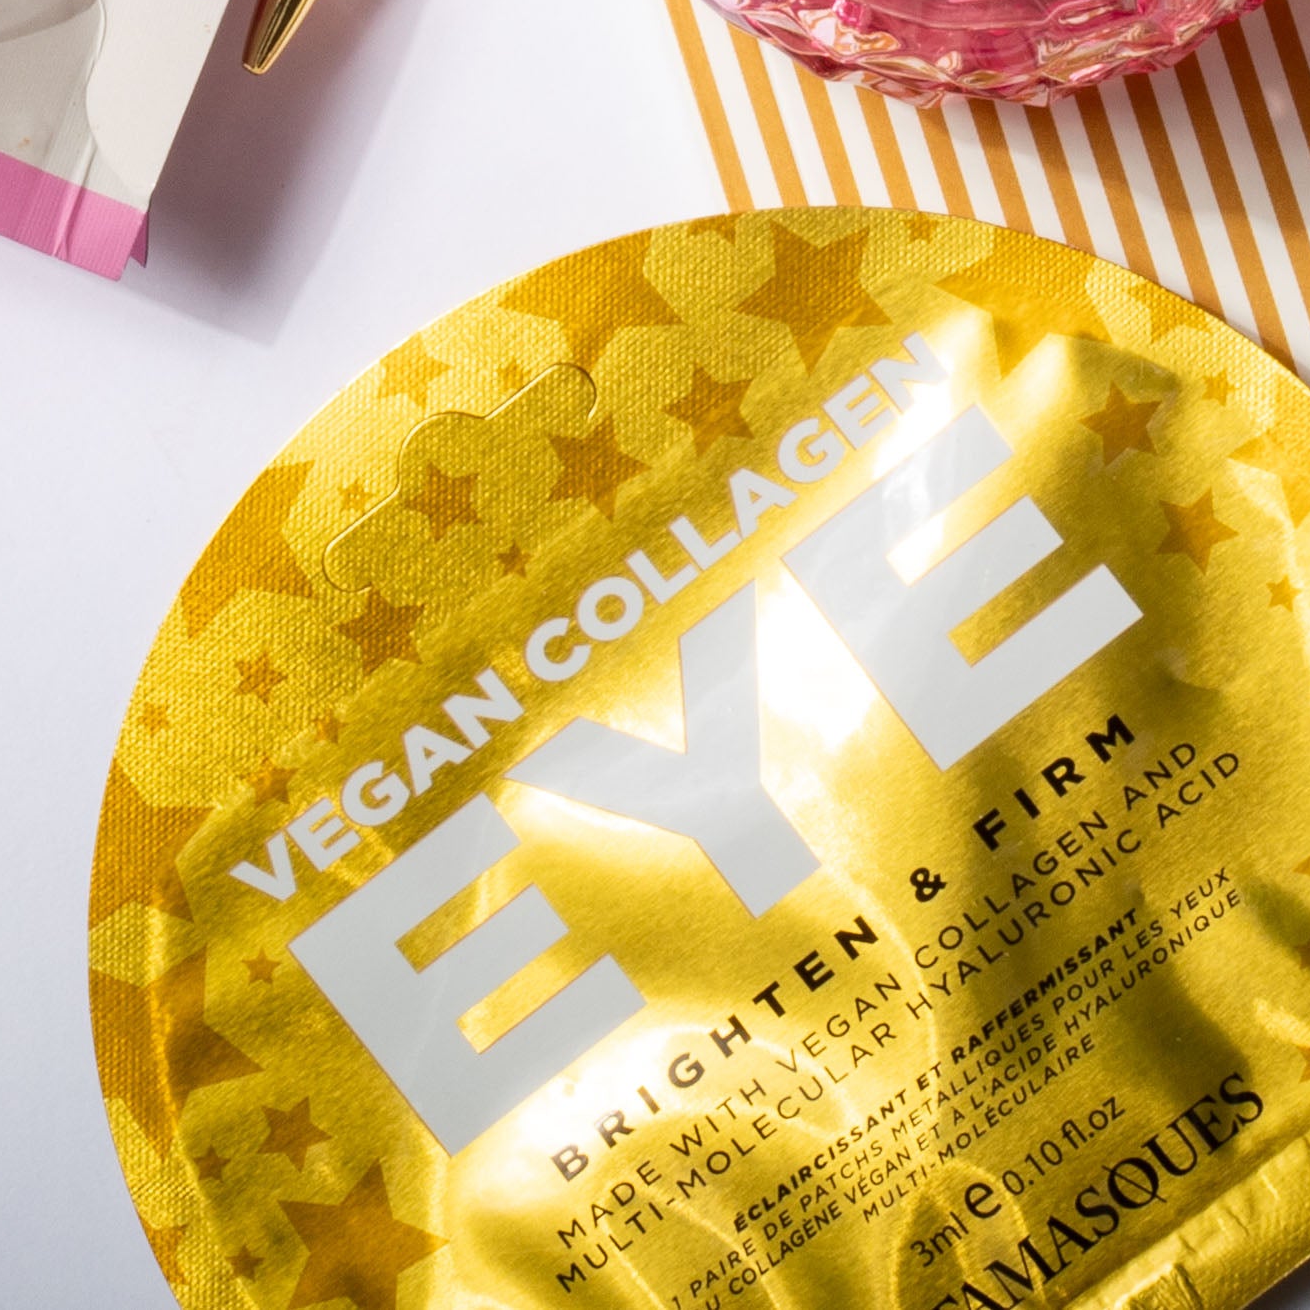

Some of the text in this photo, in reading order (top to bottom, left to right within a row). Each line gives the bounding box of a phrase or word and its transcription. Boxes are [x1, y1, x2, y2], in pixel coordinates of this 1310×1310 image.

[228, 330, 952, 904] VEGAN COLLAGEN
[285, 401, 1144, 1159] EYE
[550, 713, 1136, 1183] BRIGHTEN & FIRM
[555, 752, 1240, 1293] MULTI-MOLECULAR HYALURONIC ACID
[557, 742, 1196, 1249] MADE WITH VEGAN COLLAGEN AND
[690, 1237, 757, 1298] PAIRE
[763, 1209, 793, 1242] DE
[799, 1140, 883, 1213] PATCHS
[1052, 958, 1115, 1015] POUR
[1122, 919, 1164, 961] LES
[1170, 867, 1230, 920] YEUX
[728, 1200, 843, 1296] COLLAGÈNE
[844, 1146, 912, 1205] VÉGAN
[916, 1122, 941, 1152] ET
[970, 1032, 1058, 1110] L'ACIDE
[1064, 888, 1241, 1036] HYALURONIQUE
[733, 908, 1137, 1233] ÉCLAIRCISSANT ET RAFFERMISSANT
[862, 1032, 1096, 1224] MULTI-MOLÉCULAIRE
[910, 1211, 970, 1269] 3ml
[1001, 1140, 1064, 1197] 0.10
[1061, 1096, 1126, 1150] fl.oz
